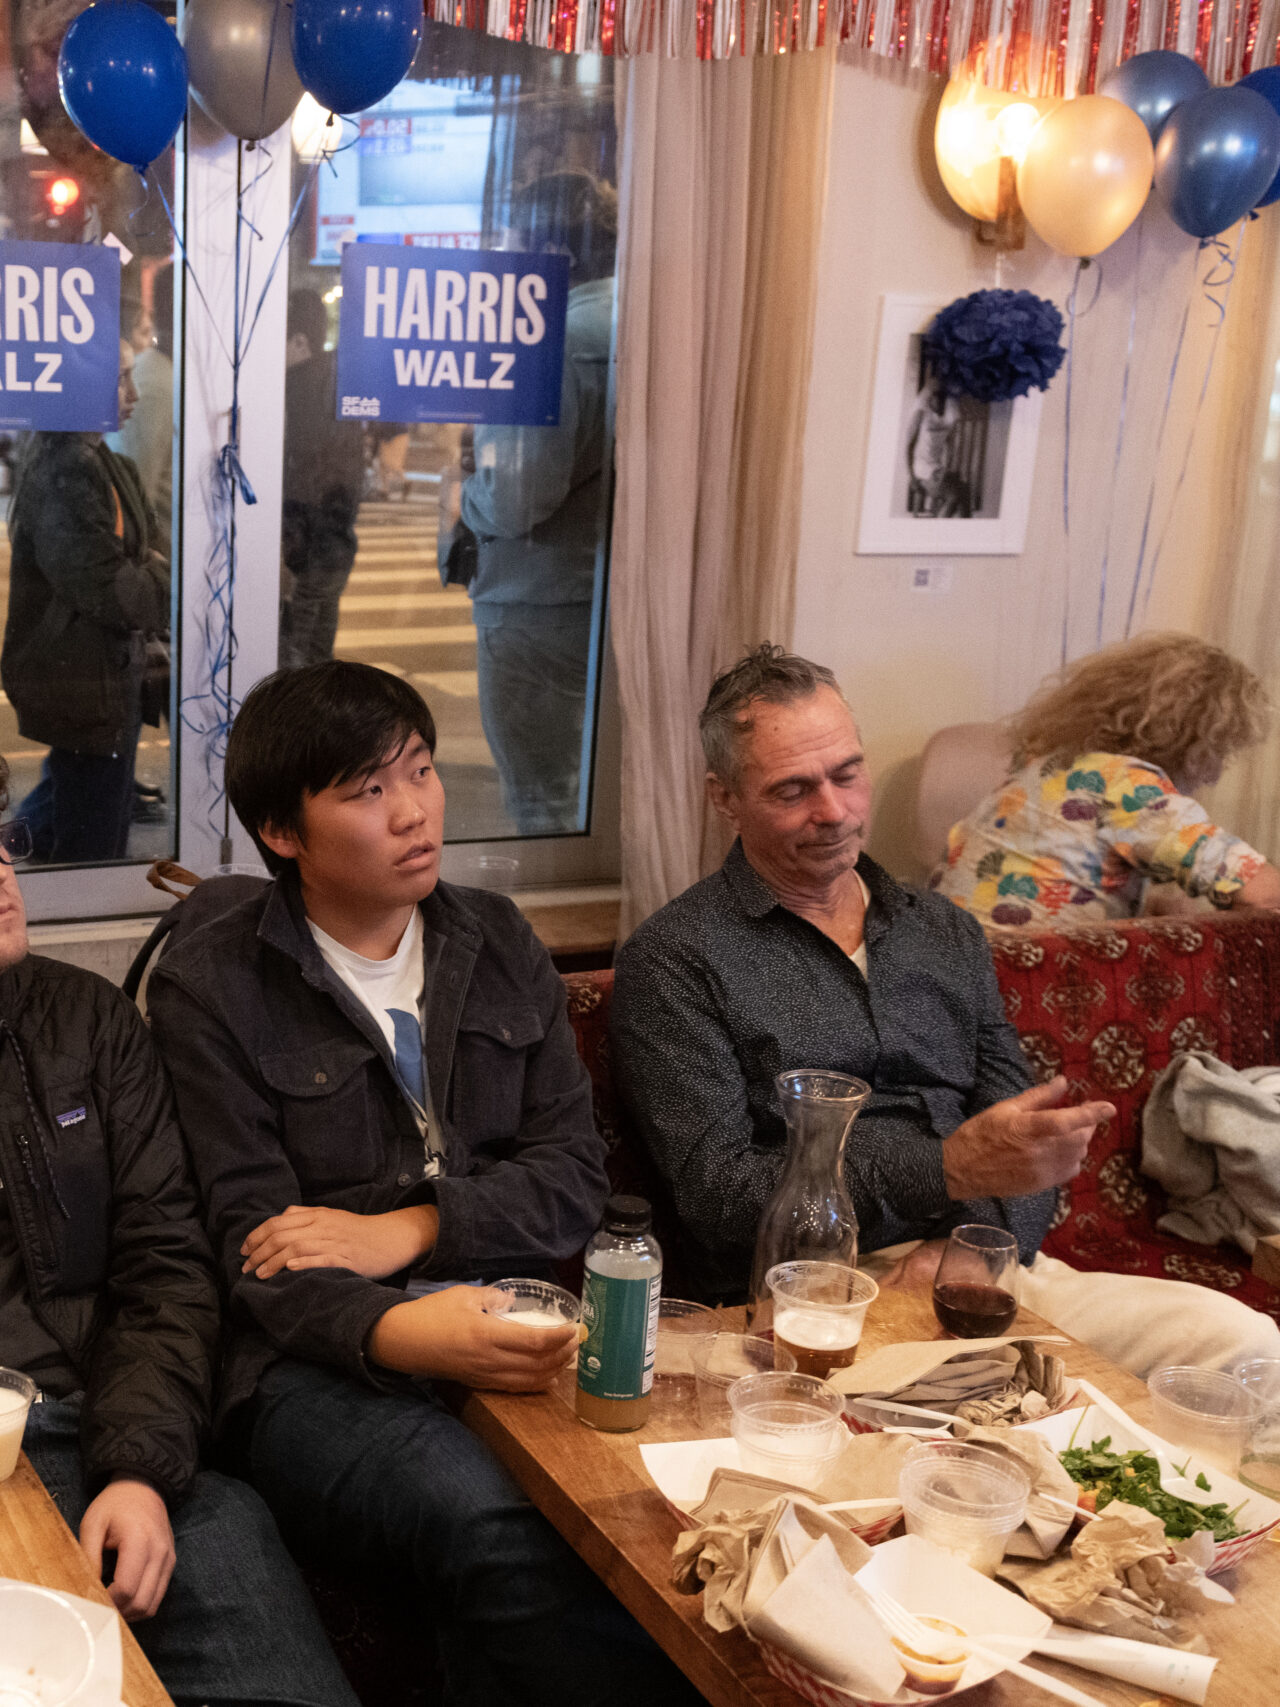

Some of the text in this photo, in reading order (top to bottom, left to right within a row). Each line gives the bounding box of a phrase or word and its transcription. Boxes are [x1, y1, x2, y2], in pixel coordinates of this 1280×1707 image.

[363, 265, 548, 346] HARRIS
[393, 348, 516, 390] WALZ
[341, 406, 381, 417] DEMS
[342, 396, 361, 407] SF
